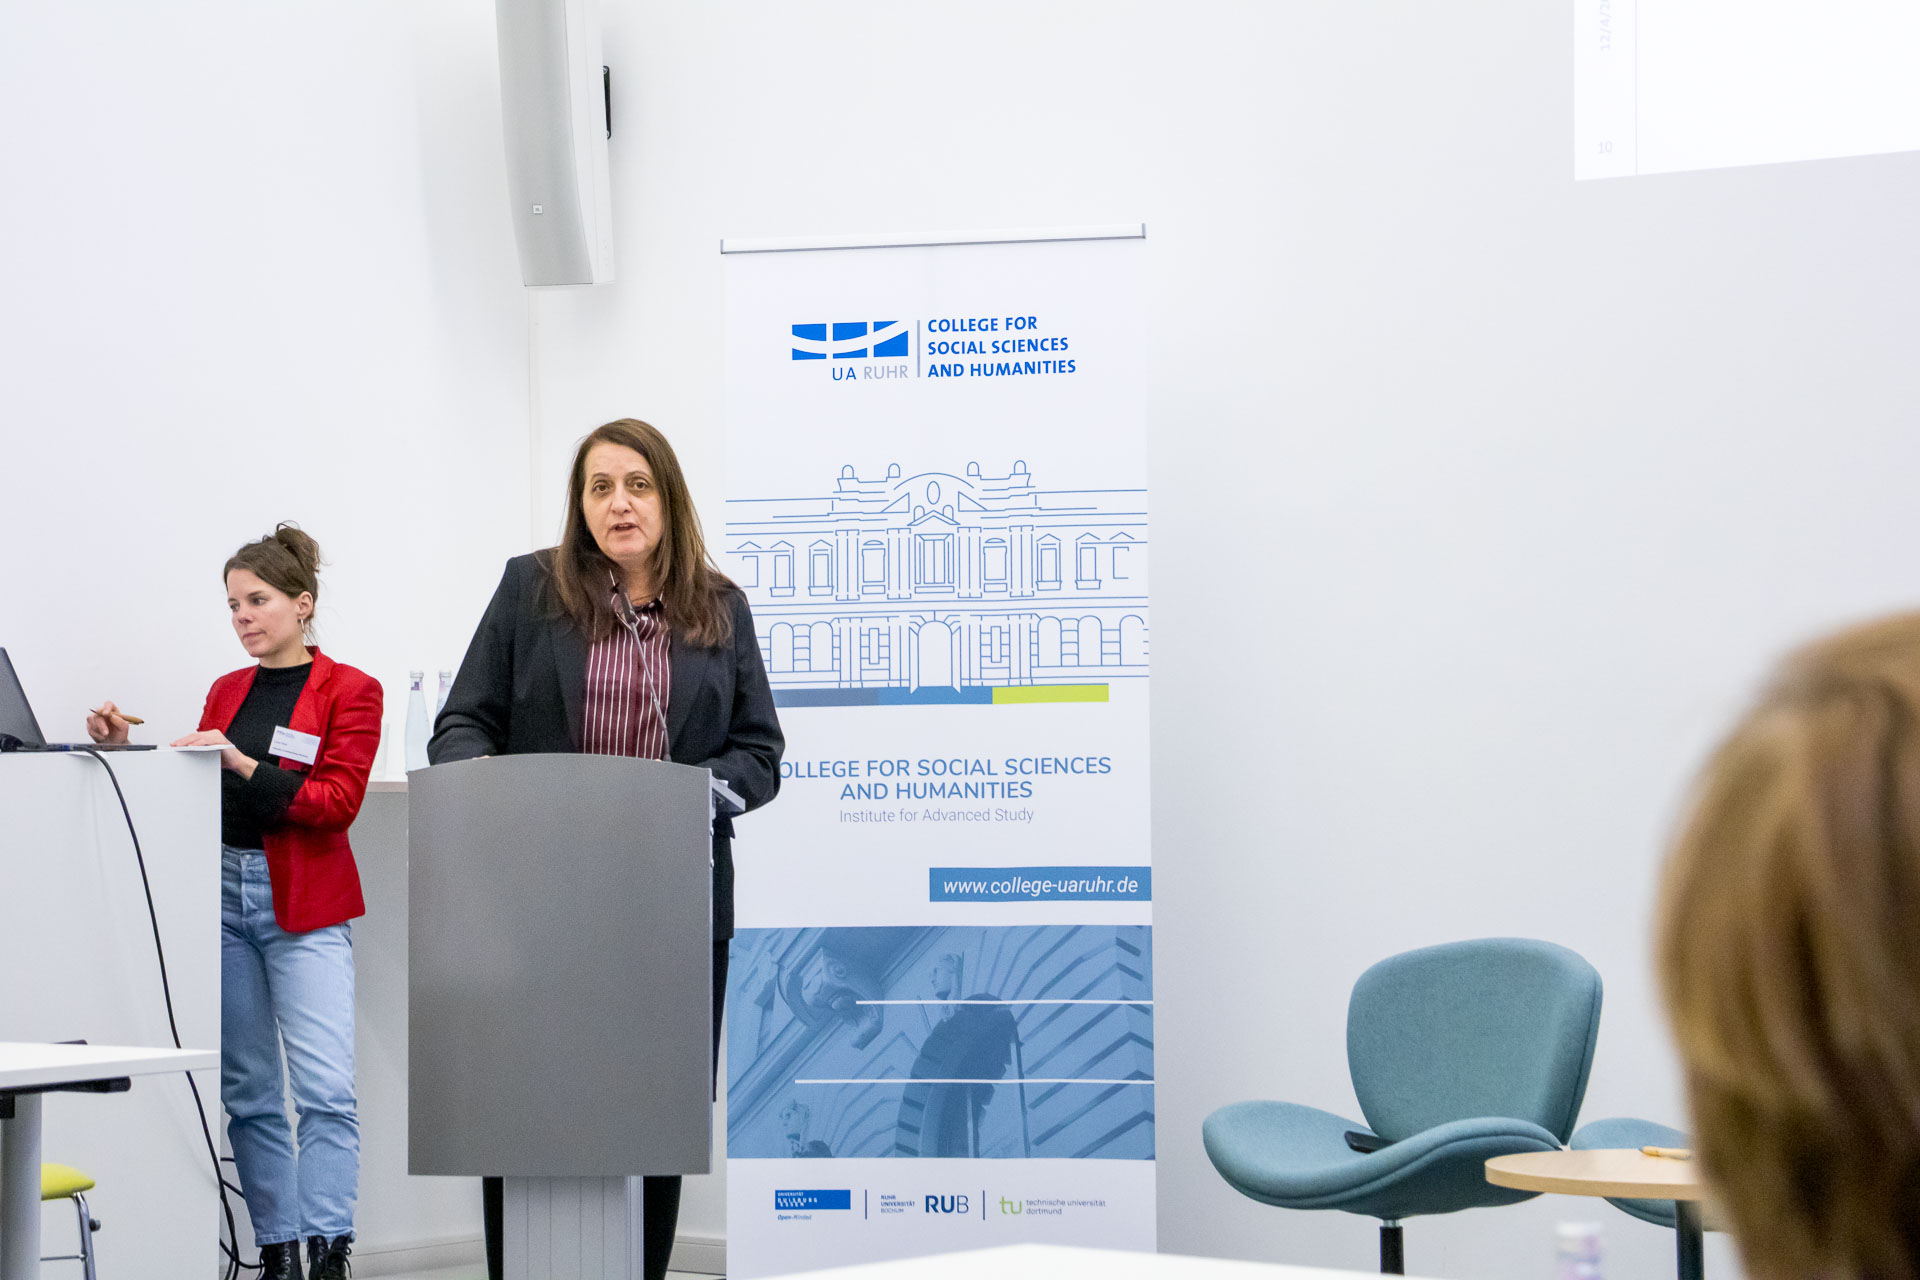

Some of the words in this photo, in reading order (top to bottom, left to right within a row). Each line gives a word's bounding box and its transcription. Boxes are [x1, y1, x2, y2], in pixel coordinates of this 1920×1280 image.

[927, 317, 999, 333] COLLEGE
[1005, 316, 1038, 331] FOR
[927, 340, 987, 355] SOCIAL
[991, 337, 1069, 354] SCIENCES
[832, 367, 857, 381] UA
[863, 365, 909, 380] RUHR
[927, 363, 965, 378] AND
[970, 359, 1077, 377] HUMANITIES
[780, 760, 861, 779] OLLEGE
[866, 759, 911, 777] FOR
[917, 758, 999, 776] SOCIAL
[1004, 756, 1112, 775] SCIENCES
[840, 783, 889, 801] AND
[896, 780, 1034, 799] HUMANITIES
[839, 808, 896, 824] Institute
[899, 808, 918, 822] for
[922, 807, 991, 822] Advanced
[995, 807, 1035, 824] Study
[943, 875, 1139, 897] www.college-uaruhr.de
[925, 1194, 970, 1214] RUB
[1000, 1196, 1023, 1215] tu
[1026, 1199, 1066, 1207] technische
[1026, 1207, 1063, 1215] dortmund
